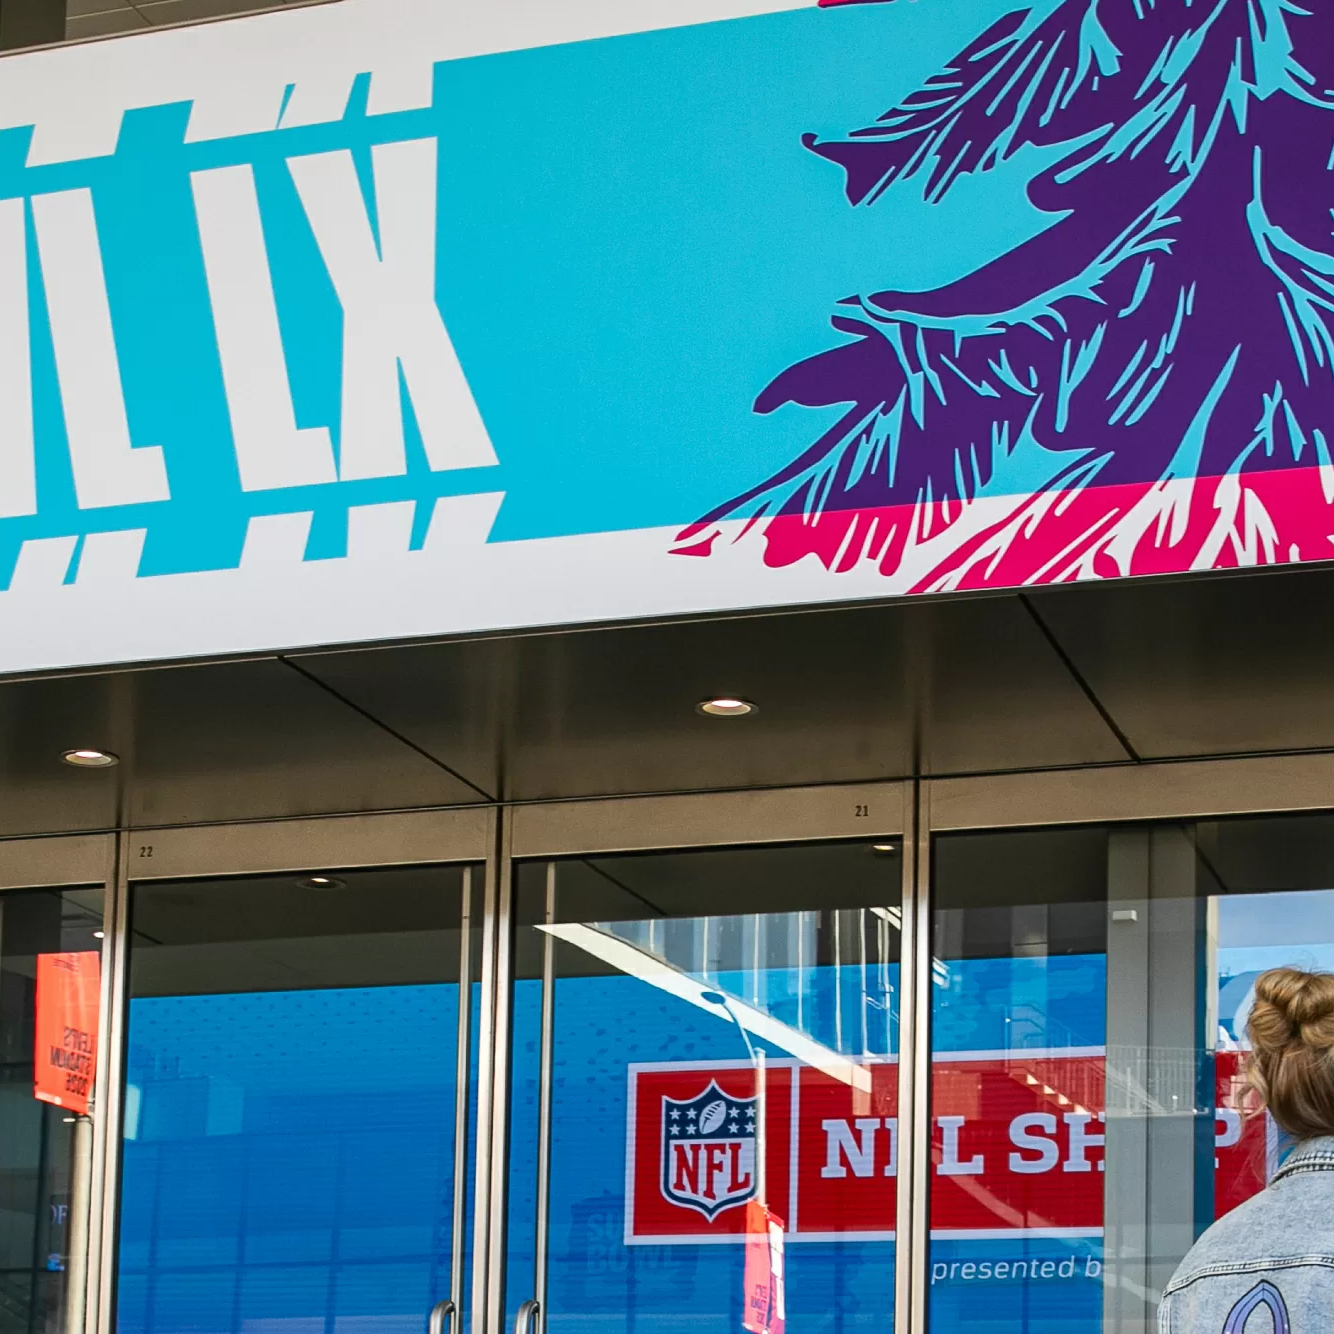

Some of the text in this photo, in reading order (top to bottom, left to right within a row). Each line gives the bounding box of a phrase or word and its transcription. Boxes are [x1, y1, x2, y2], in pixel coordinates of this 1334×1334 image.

[189, 136, 500, 492] LX
[855, 805, 869, 817] 21
[140, 846, 153, 858] 22
[673, 1142, 751, 1201] NFL
[931, 1254, 1103, 1285] presented b
